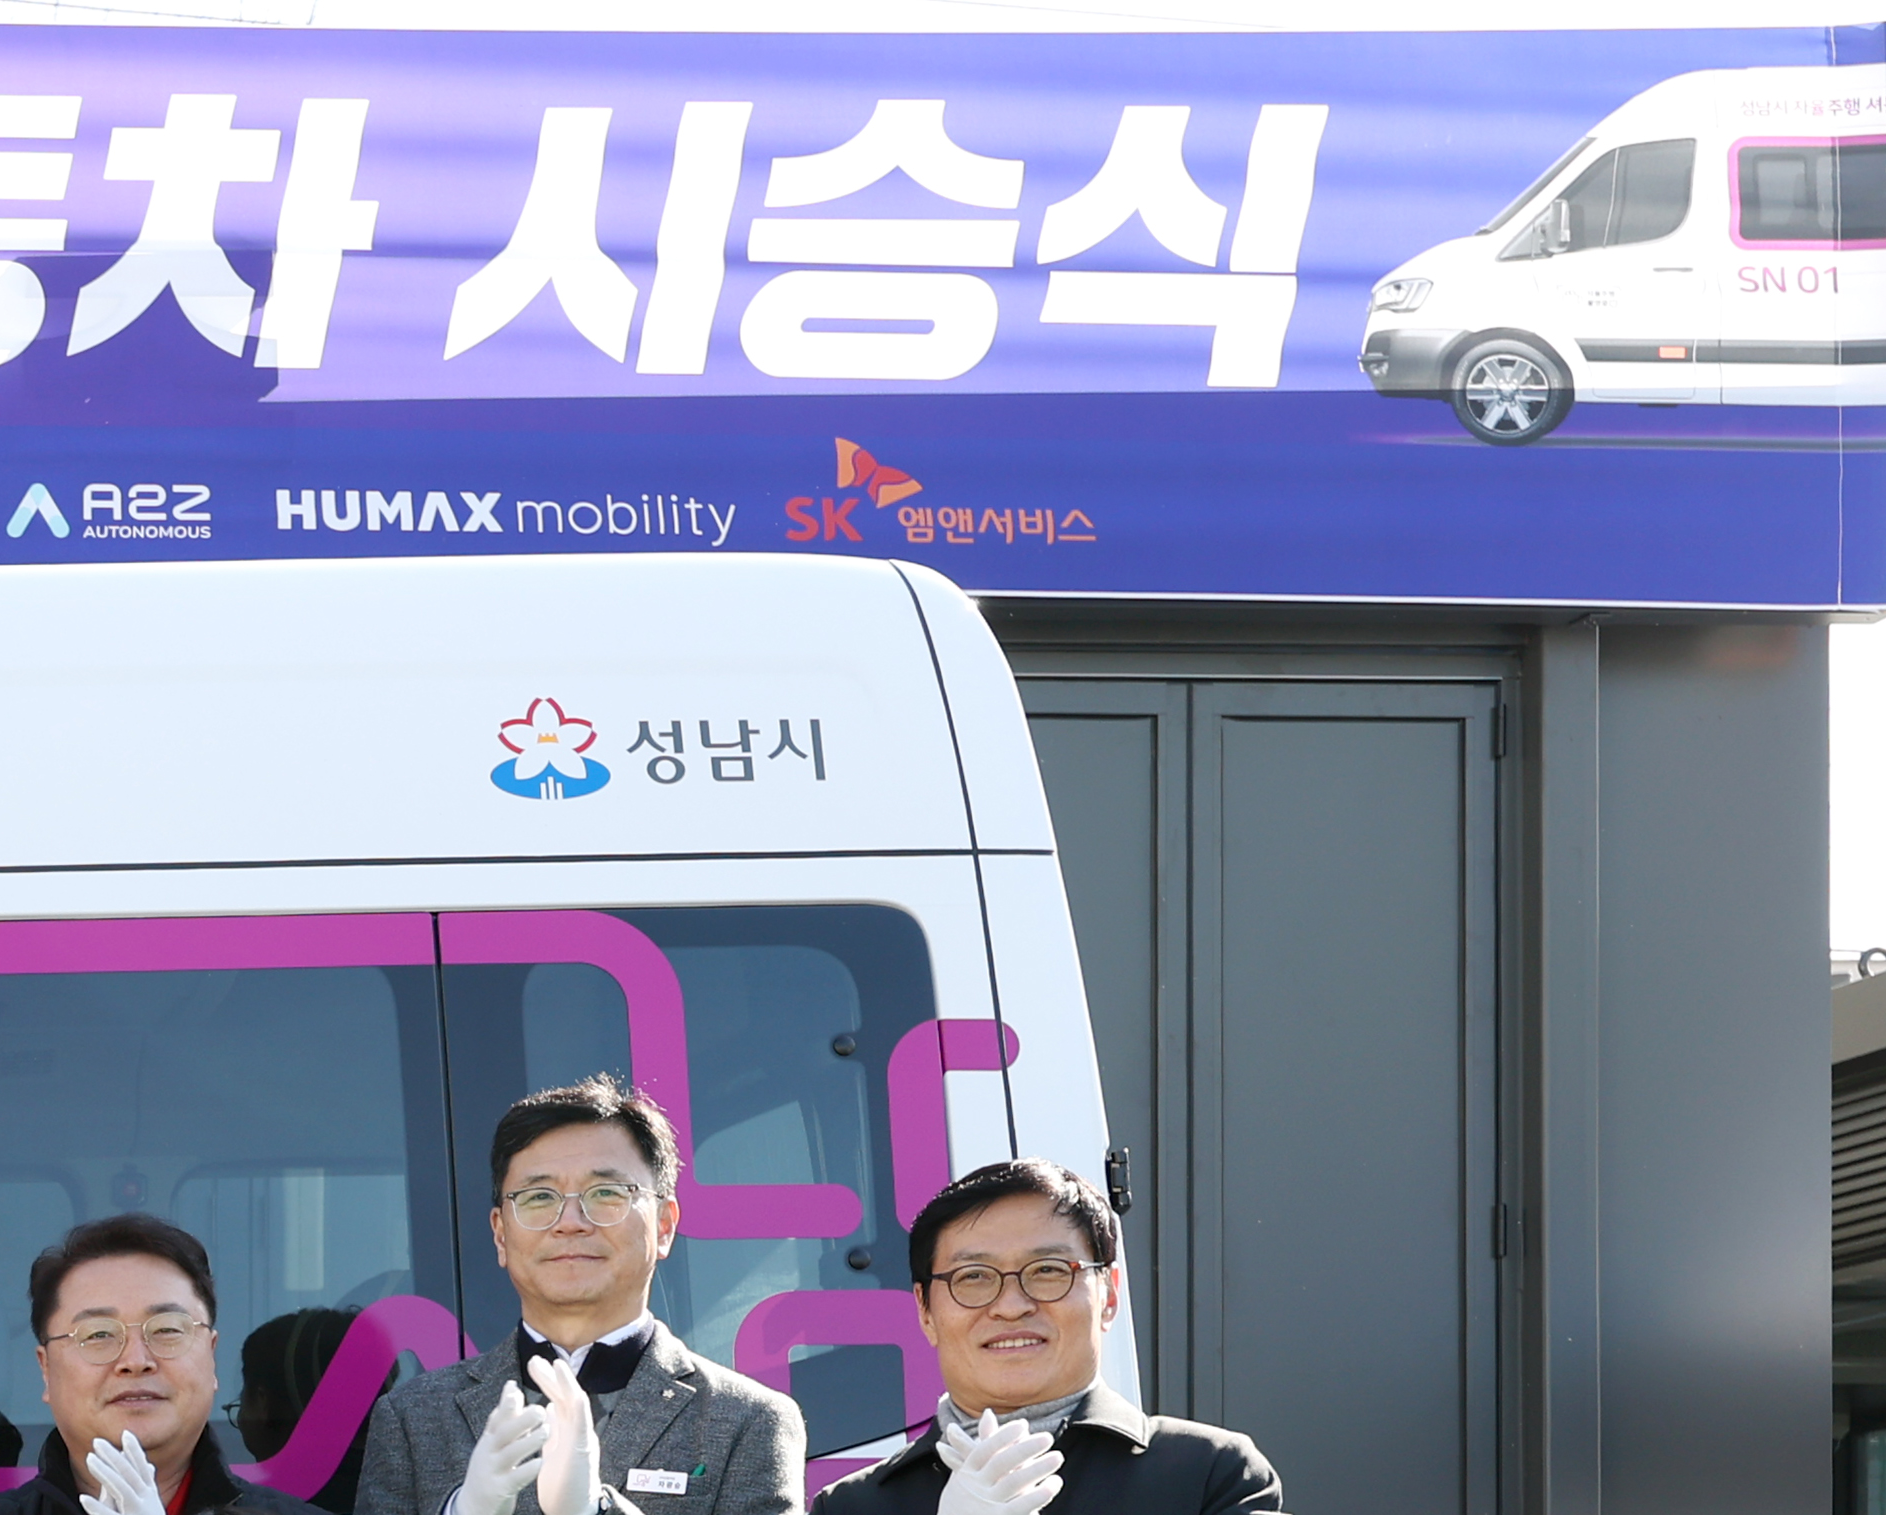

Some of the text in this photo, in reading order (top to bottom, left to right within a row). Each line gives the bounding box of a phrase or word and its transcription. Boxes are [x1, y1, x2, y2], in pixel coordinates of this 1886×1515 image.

[1866, 95, 1886, 113] 셔
[444, 100, 1329, 387] 시승식
[1738, 266, 1839, 293] SN 01
[83, 483, 212, 521] A2Z
[276, 489, 736, 547] HUMAX mobility
[785, 497, 1096, 544] SK 엠앤서비스
[83, 525, 212, 539] AUTONOMOUS
[626, 719, 826, 785] 성남시
